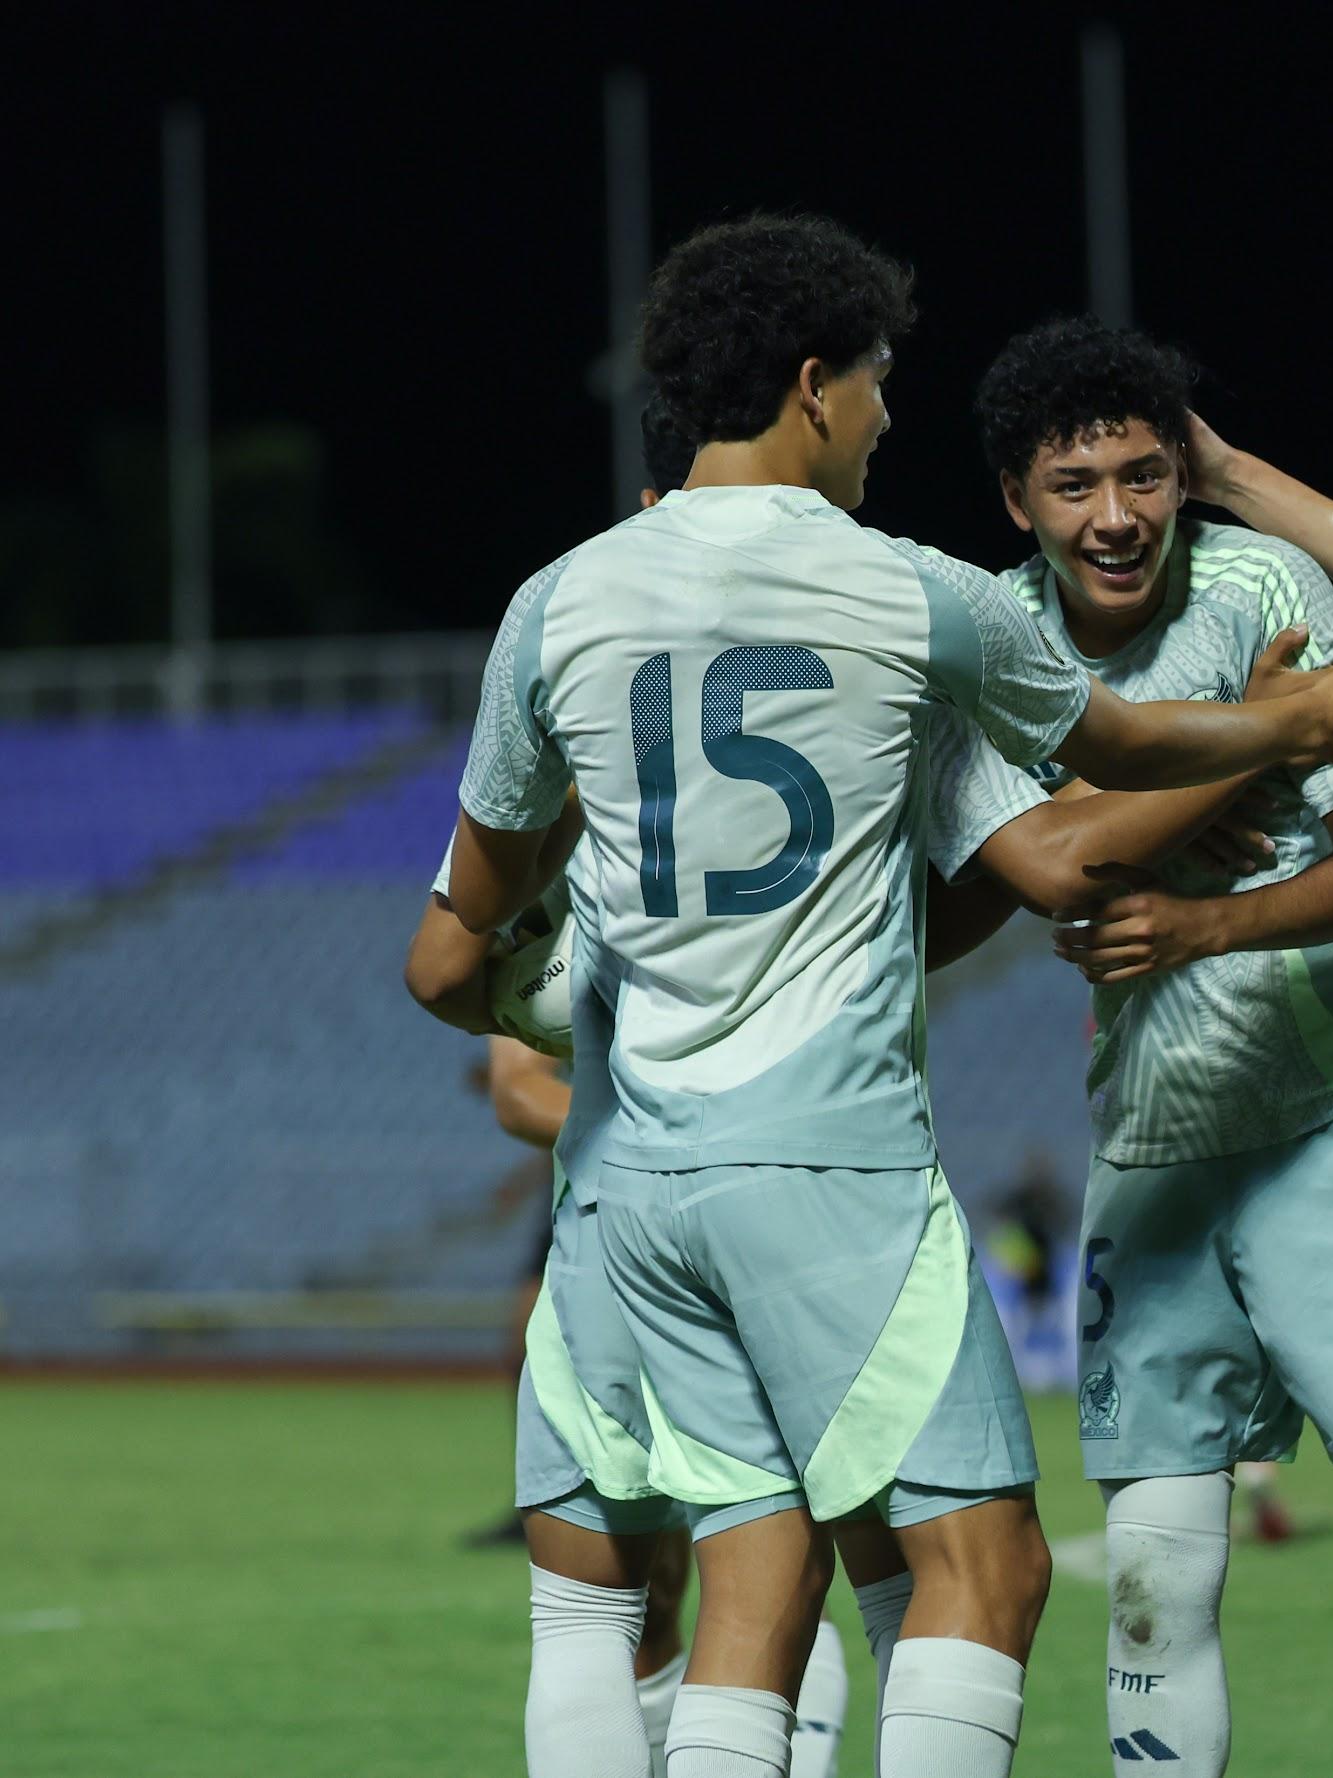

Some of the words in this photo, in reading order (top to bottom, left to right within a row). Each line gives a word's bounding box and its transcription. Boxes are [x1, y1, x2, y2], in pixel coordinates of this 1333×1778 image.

[630, 645, 834, 918] 15
[516, 960, 565, 1001] molten
[1083, 1238, 1115, 1342] 5
[1109, 1667, 1165, 1694] FMF
